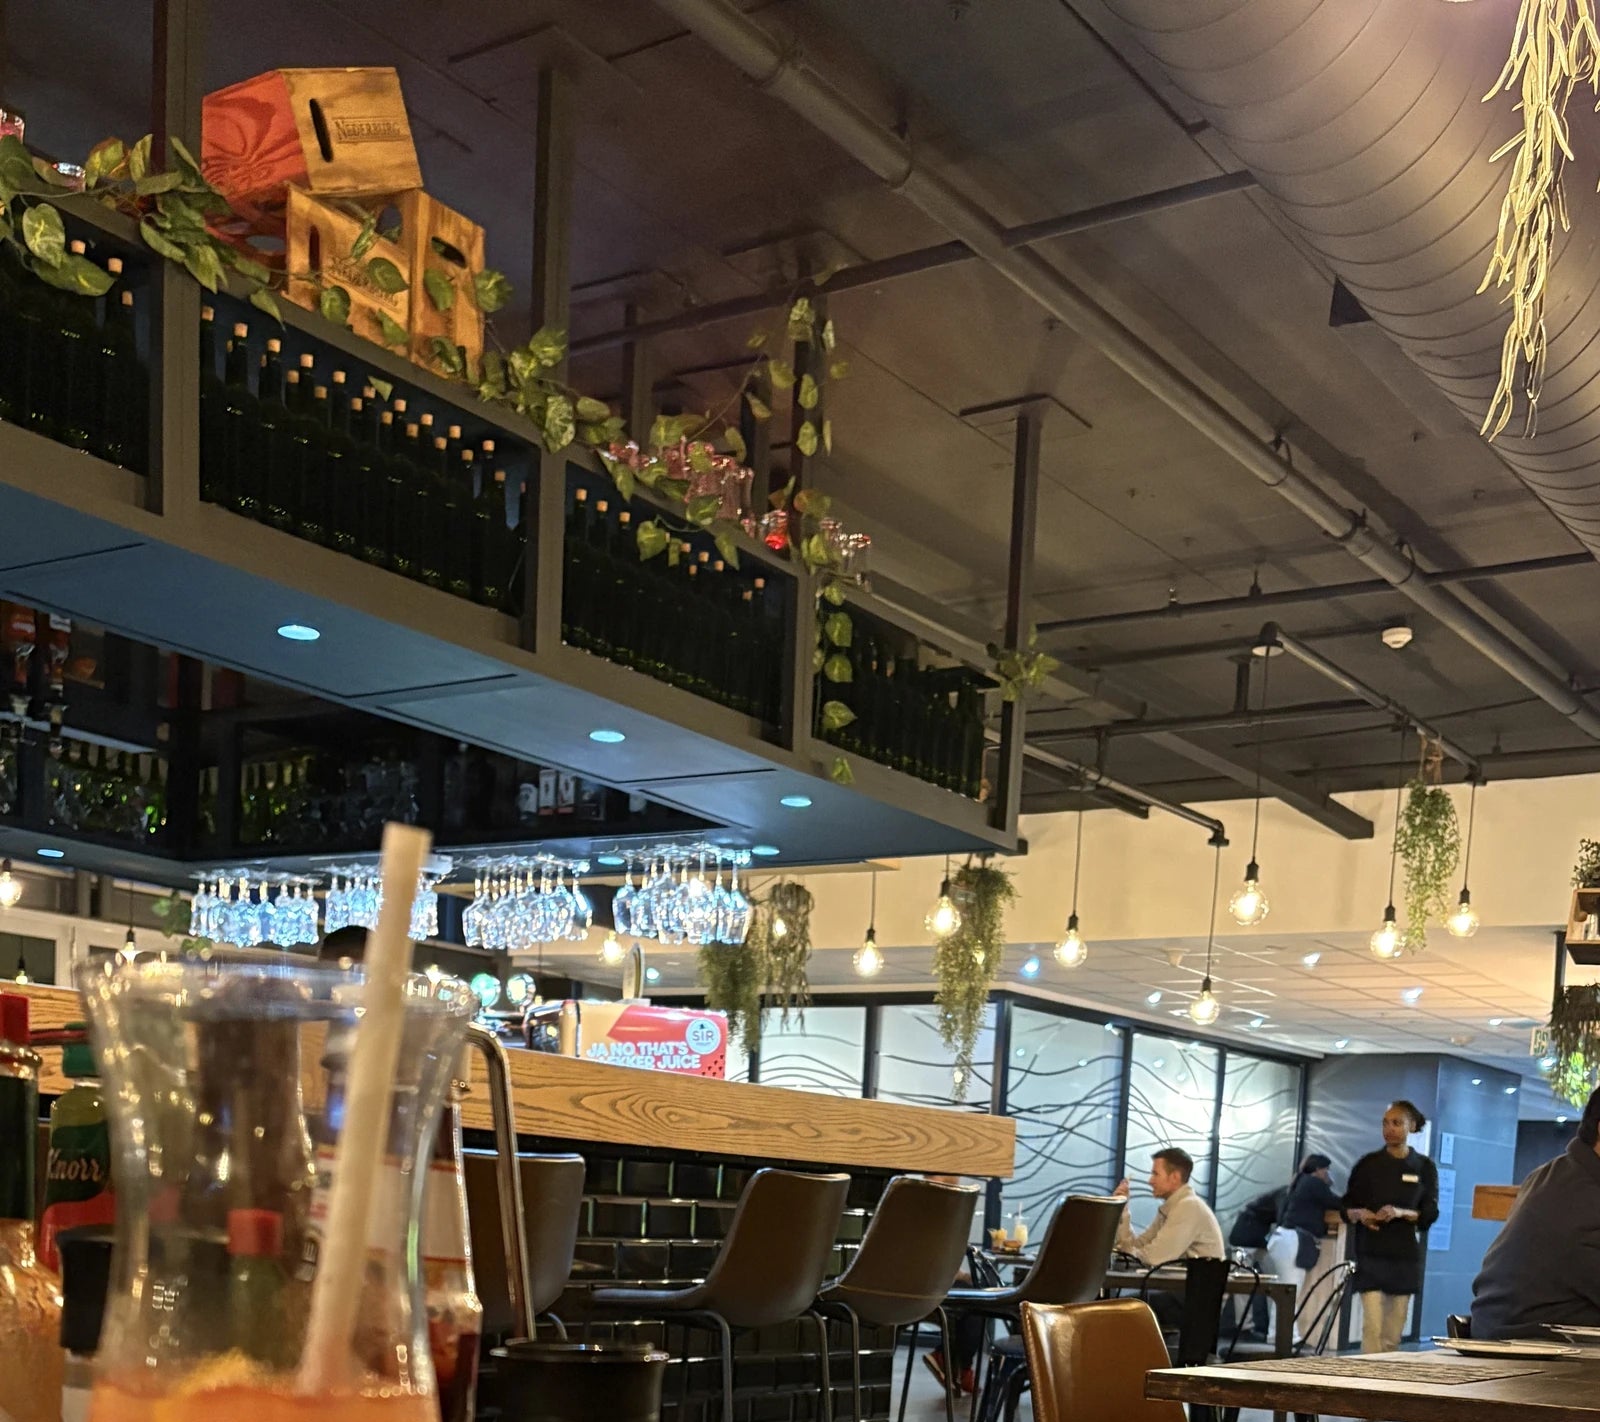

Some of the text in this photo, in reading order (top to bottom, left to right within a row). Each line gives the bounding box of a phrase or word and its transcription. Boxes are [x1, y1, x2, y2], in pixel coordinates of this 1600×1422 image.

[692, 1030, 714, 1041] SIR
[586, 1042, 608, 1057] JA
[610, 1042, 635, 1056] NO
[656, 1054, 702, 1069] JUICE
